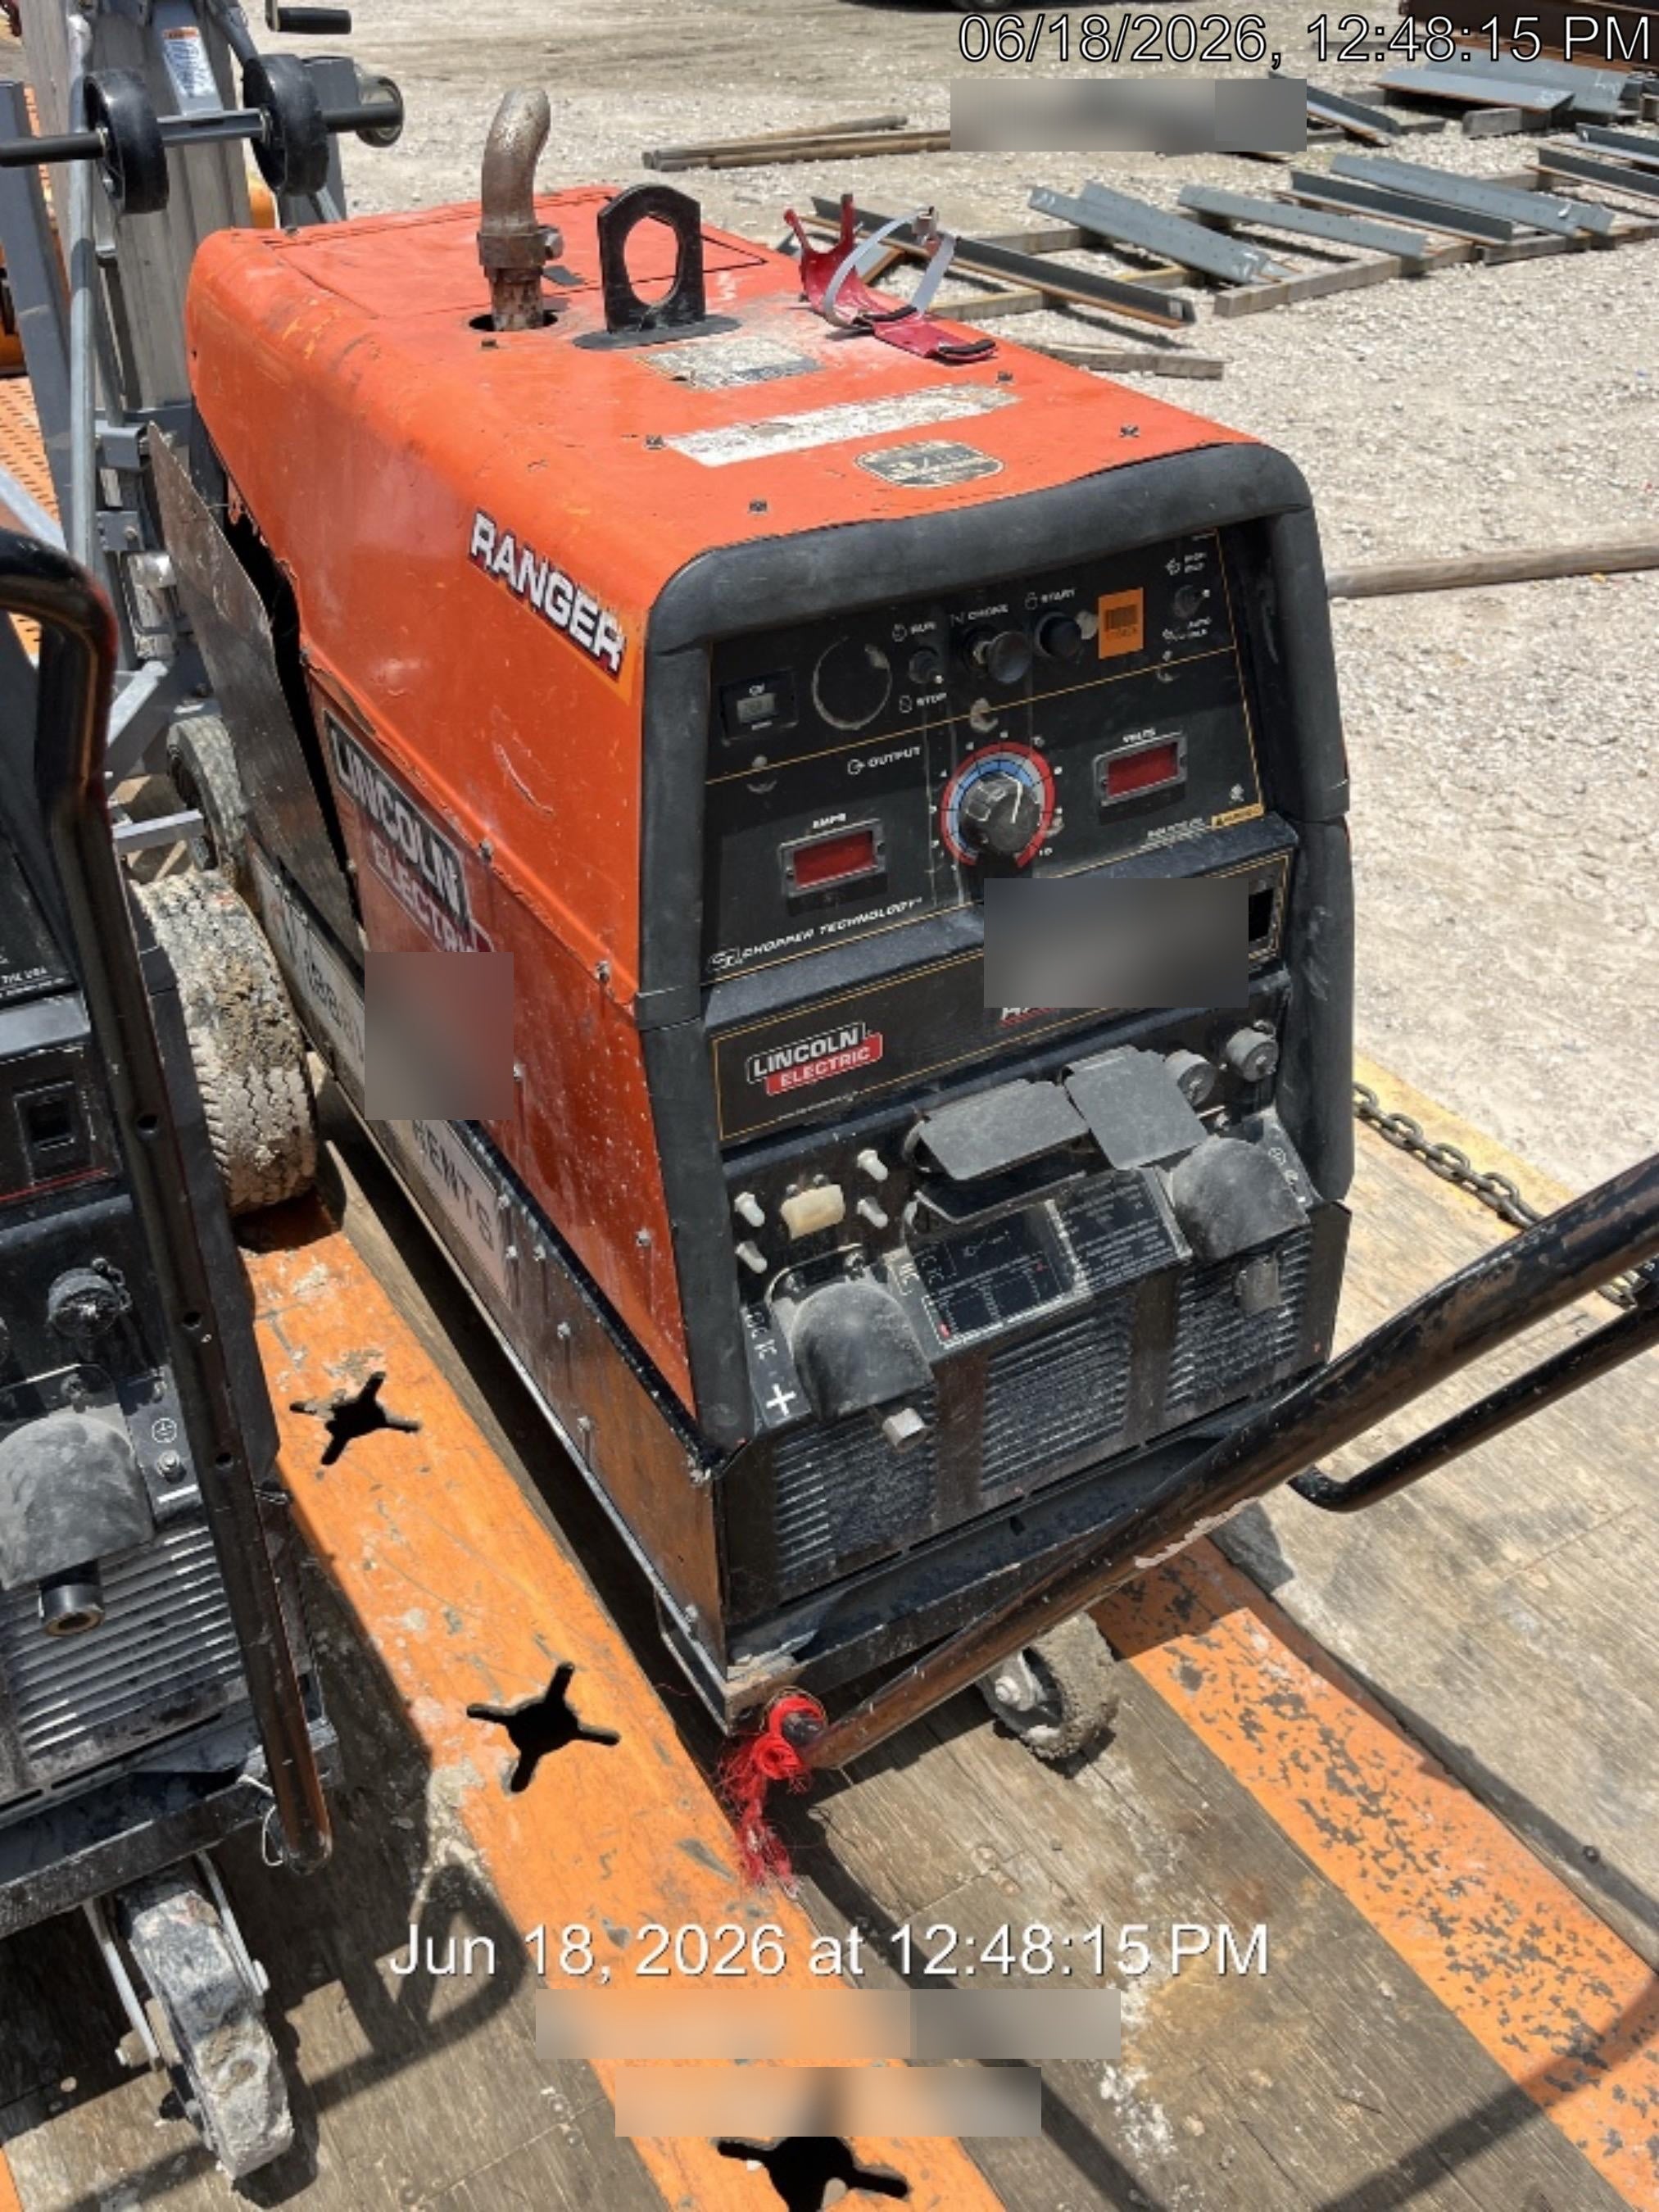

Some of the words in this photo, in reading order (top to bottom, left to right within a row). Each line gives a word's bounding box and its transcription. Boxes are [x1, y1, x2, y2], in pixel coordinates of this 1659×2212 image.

[470, 510, 626, 677] RANGER
[867, 746, 922, 768] OUTPUT
[331, 728, 465, 915] LINCOLN
[753, 1027, 859, 1077] LINCOLN
[780, 1045, 871, 1089] ELECTRIC
